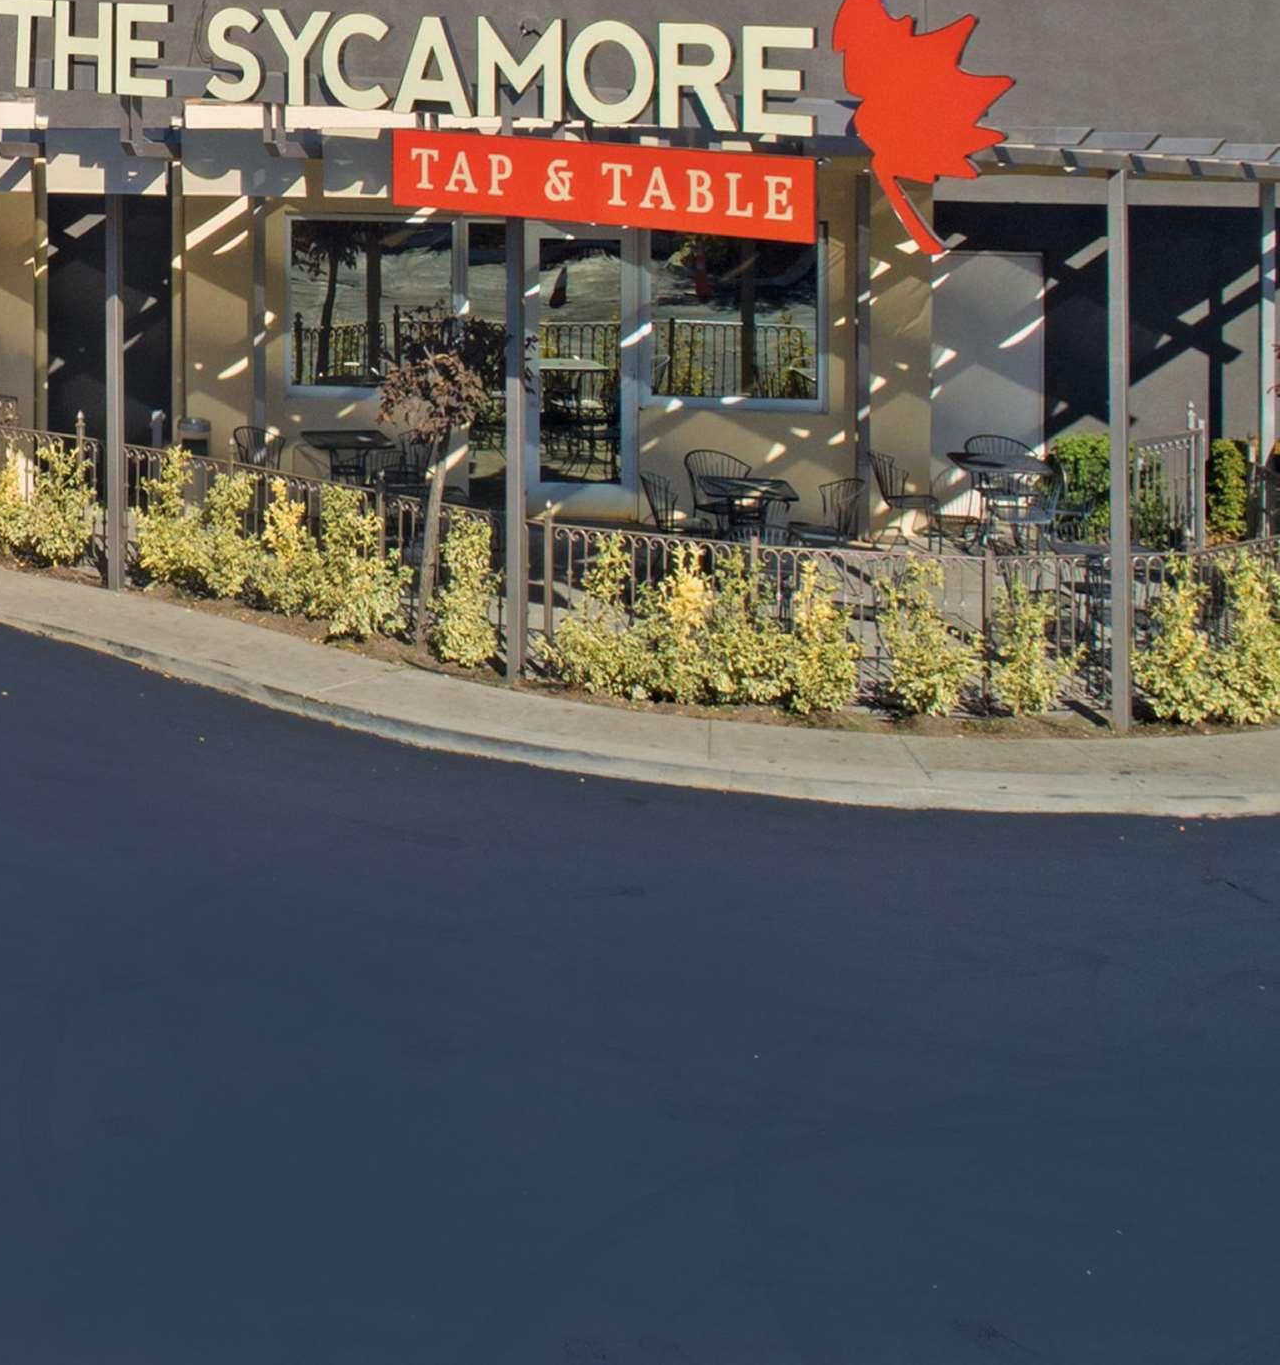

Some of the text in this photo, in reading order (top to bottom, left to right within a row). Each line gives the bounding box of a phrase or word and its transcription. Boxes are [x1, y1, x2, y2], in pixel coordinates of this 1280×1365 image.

[205, 5, 814, 137] SYCAMORE
[411, 147, 794, 223] TAP & TABLE
